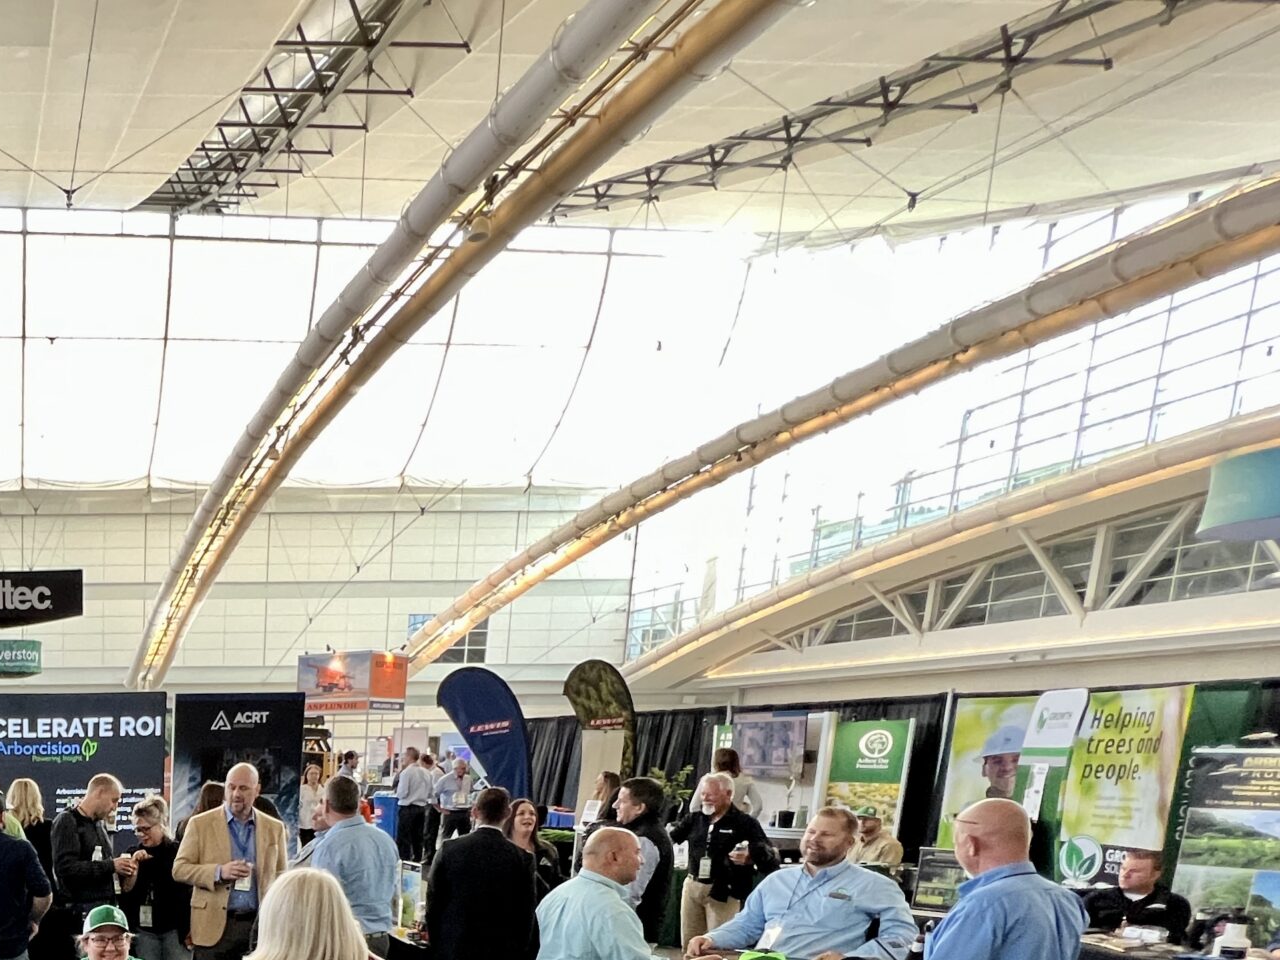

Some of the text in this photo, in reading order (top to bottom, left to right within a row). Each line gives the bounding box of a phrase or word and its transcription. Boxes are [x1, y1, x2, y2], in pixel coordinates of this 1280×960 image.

[307, 702, 358, 711] ASPLUNDH
[233, 711, 270, 723] ACRT
[1090, 706, 1156, 734] Helping
[119, 716, 162, 737] ROI
[470, 720, 510, 732] LEWIS
[1086, 730, 1163, 755] trees and
[32, 755, 61, 763] Powering
[1080, 758, 1141, 786] people.
